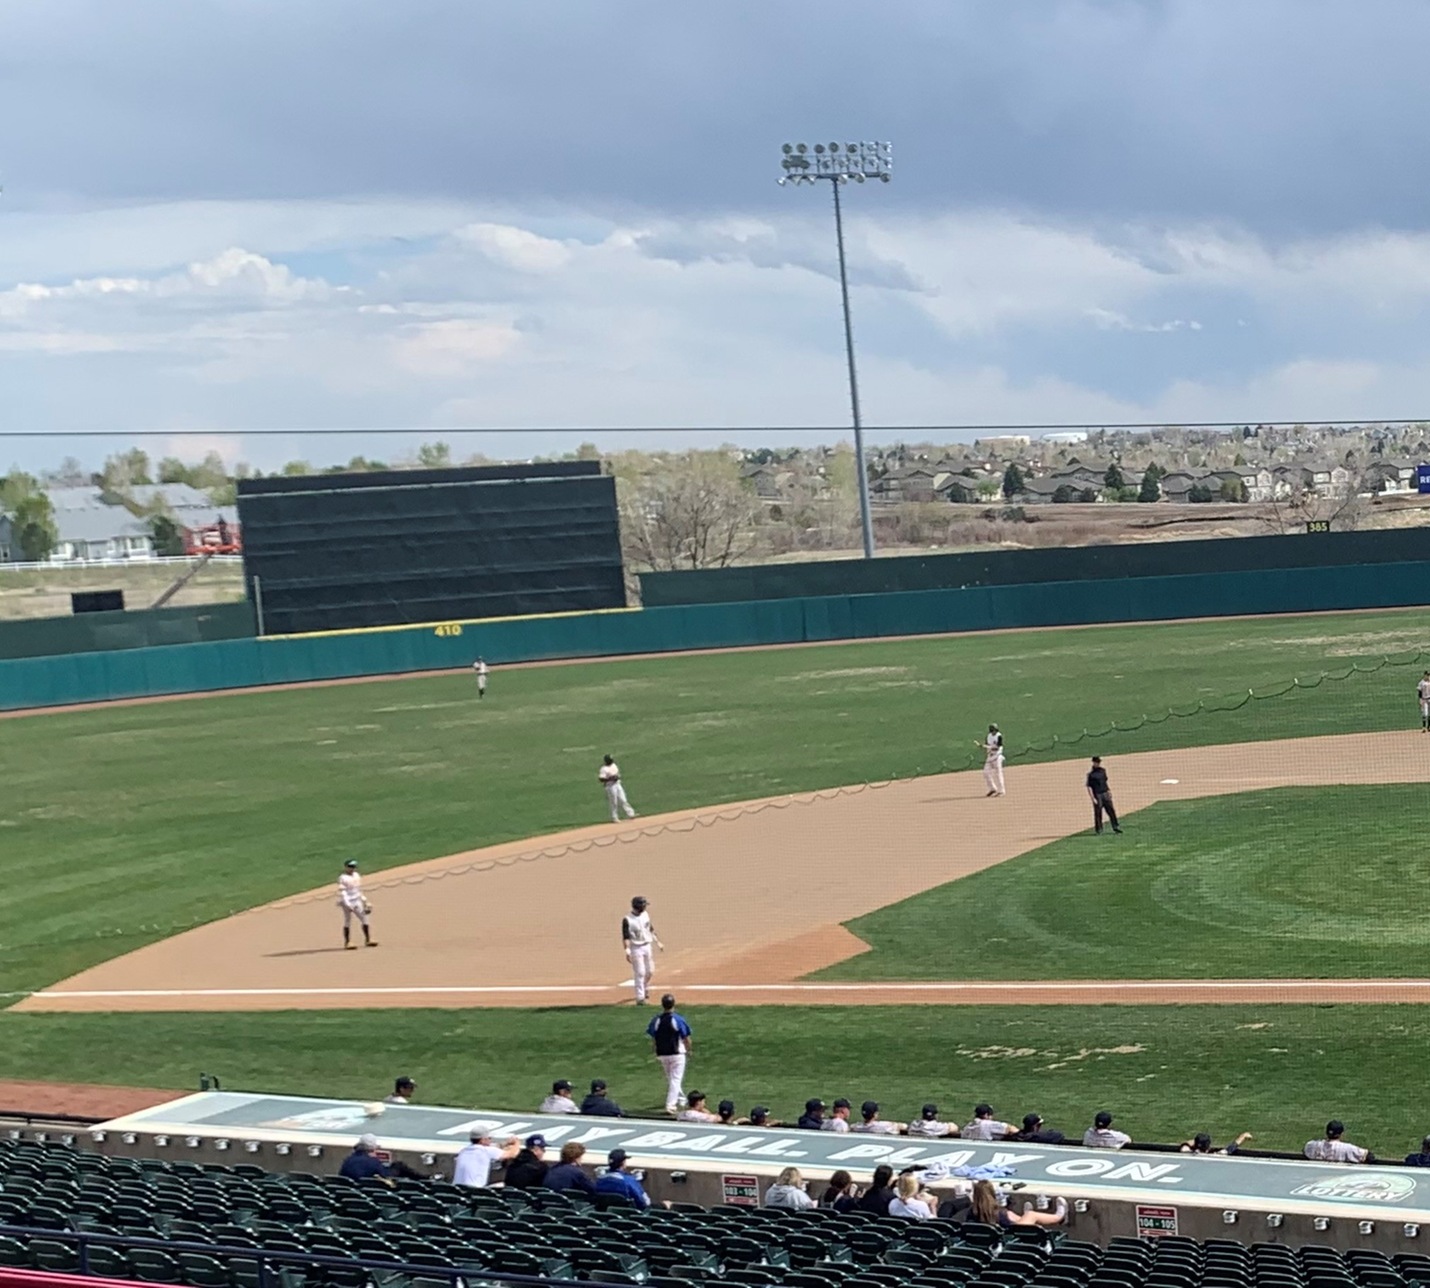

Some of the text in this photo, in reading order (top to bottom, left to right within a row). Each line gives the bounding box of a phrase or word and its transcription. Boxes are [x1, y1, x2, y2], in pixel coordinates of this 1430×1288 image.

[1309, 522, 1328, 532] 385
[434, 625, 462, 637] 410
[437, 1120, 635, 1143] PLAY
[826, 1144, 1045, 1168] PLAY
[1045, 1158, 1184, 1183] ON.
[1299, 1184, 1403, 1201] LOTTERY
